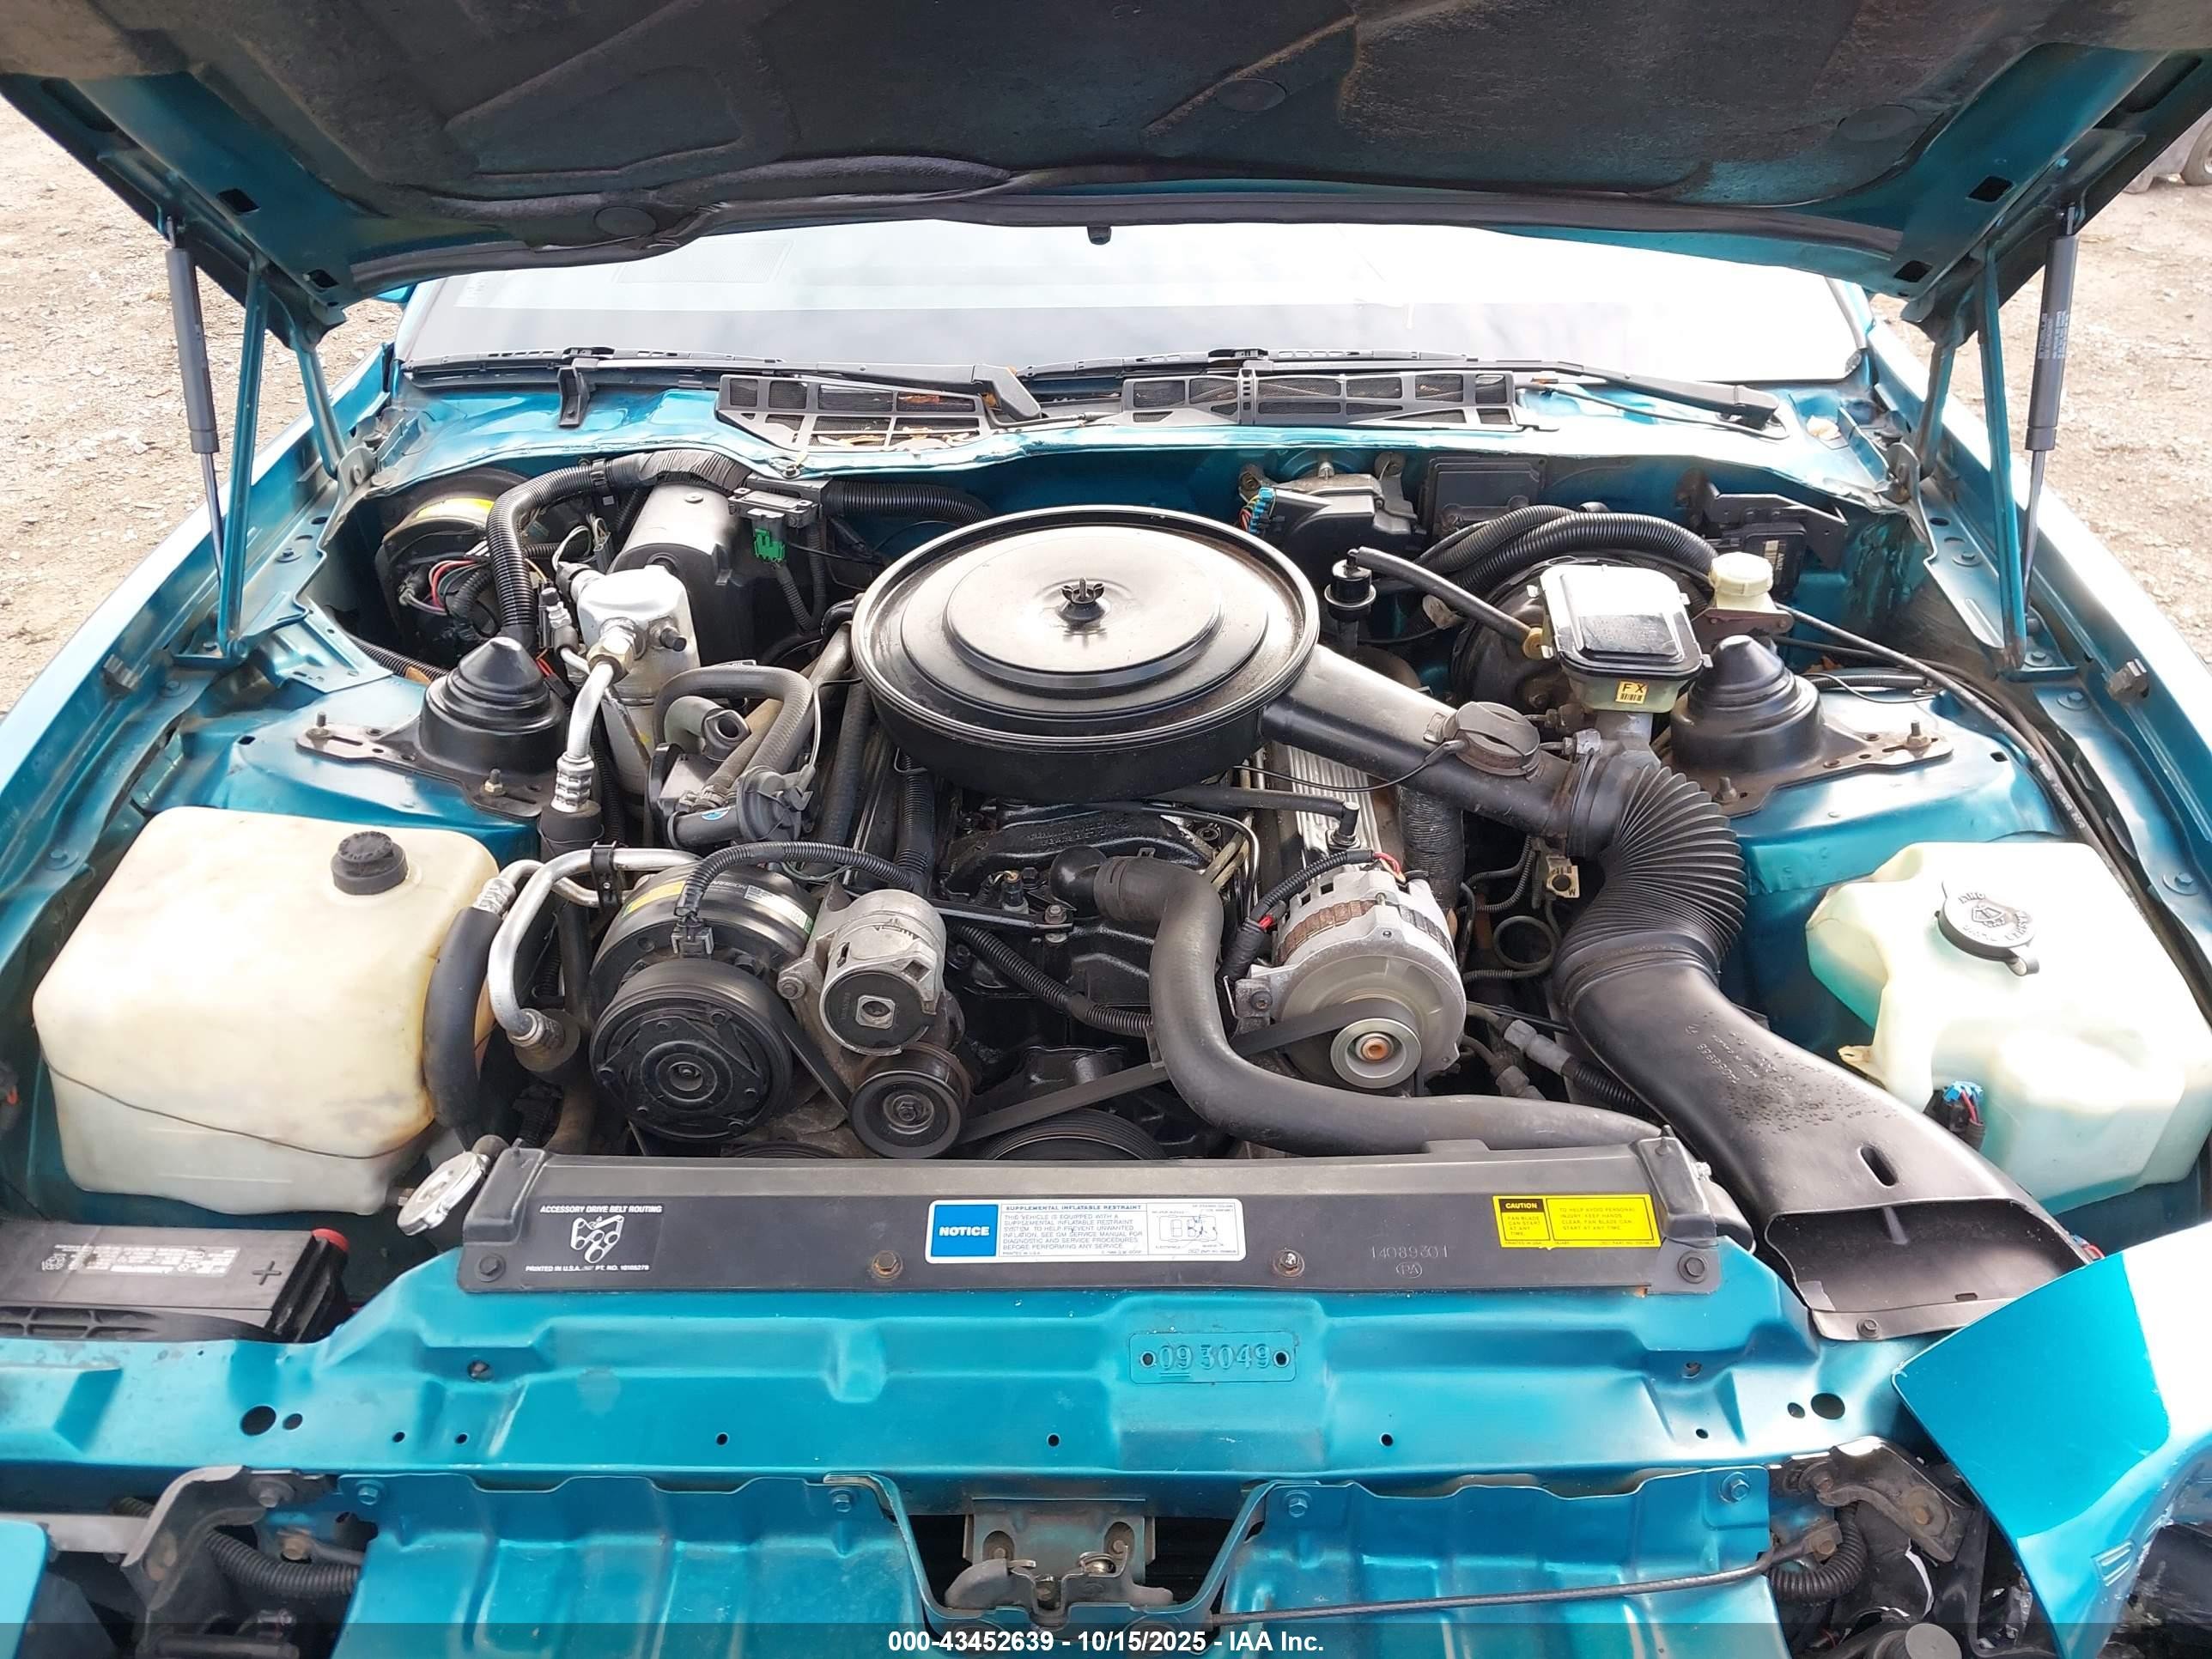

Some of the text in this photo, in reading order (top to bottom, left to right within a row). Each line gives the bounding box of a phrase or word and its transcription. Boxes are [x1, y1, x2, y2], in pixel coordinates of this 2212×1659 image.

[539, 1205, 663, 1213] ACCESSORY DRIVE BELT ROUTING
[939, 1225, 990, 1237] NOTICE
[1371, 1245, 1448, 1259] 14089301
